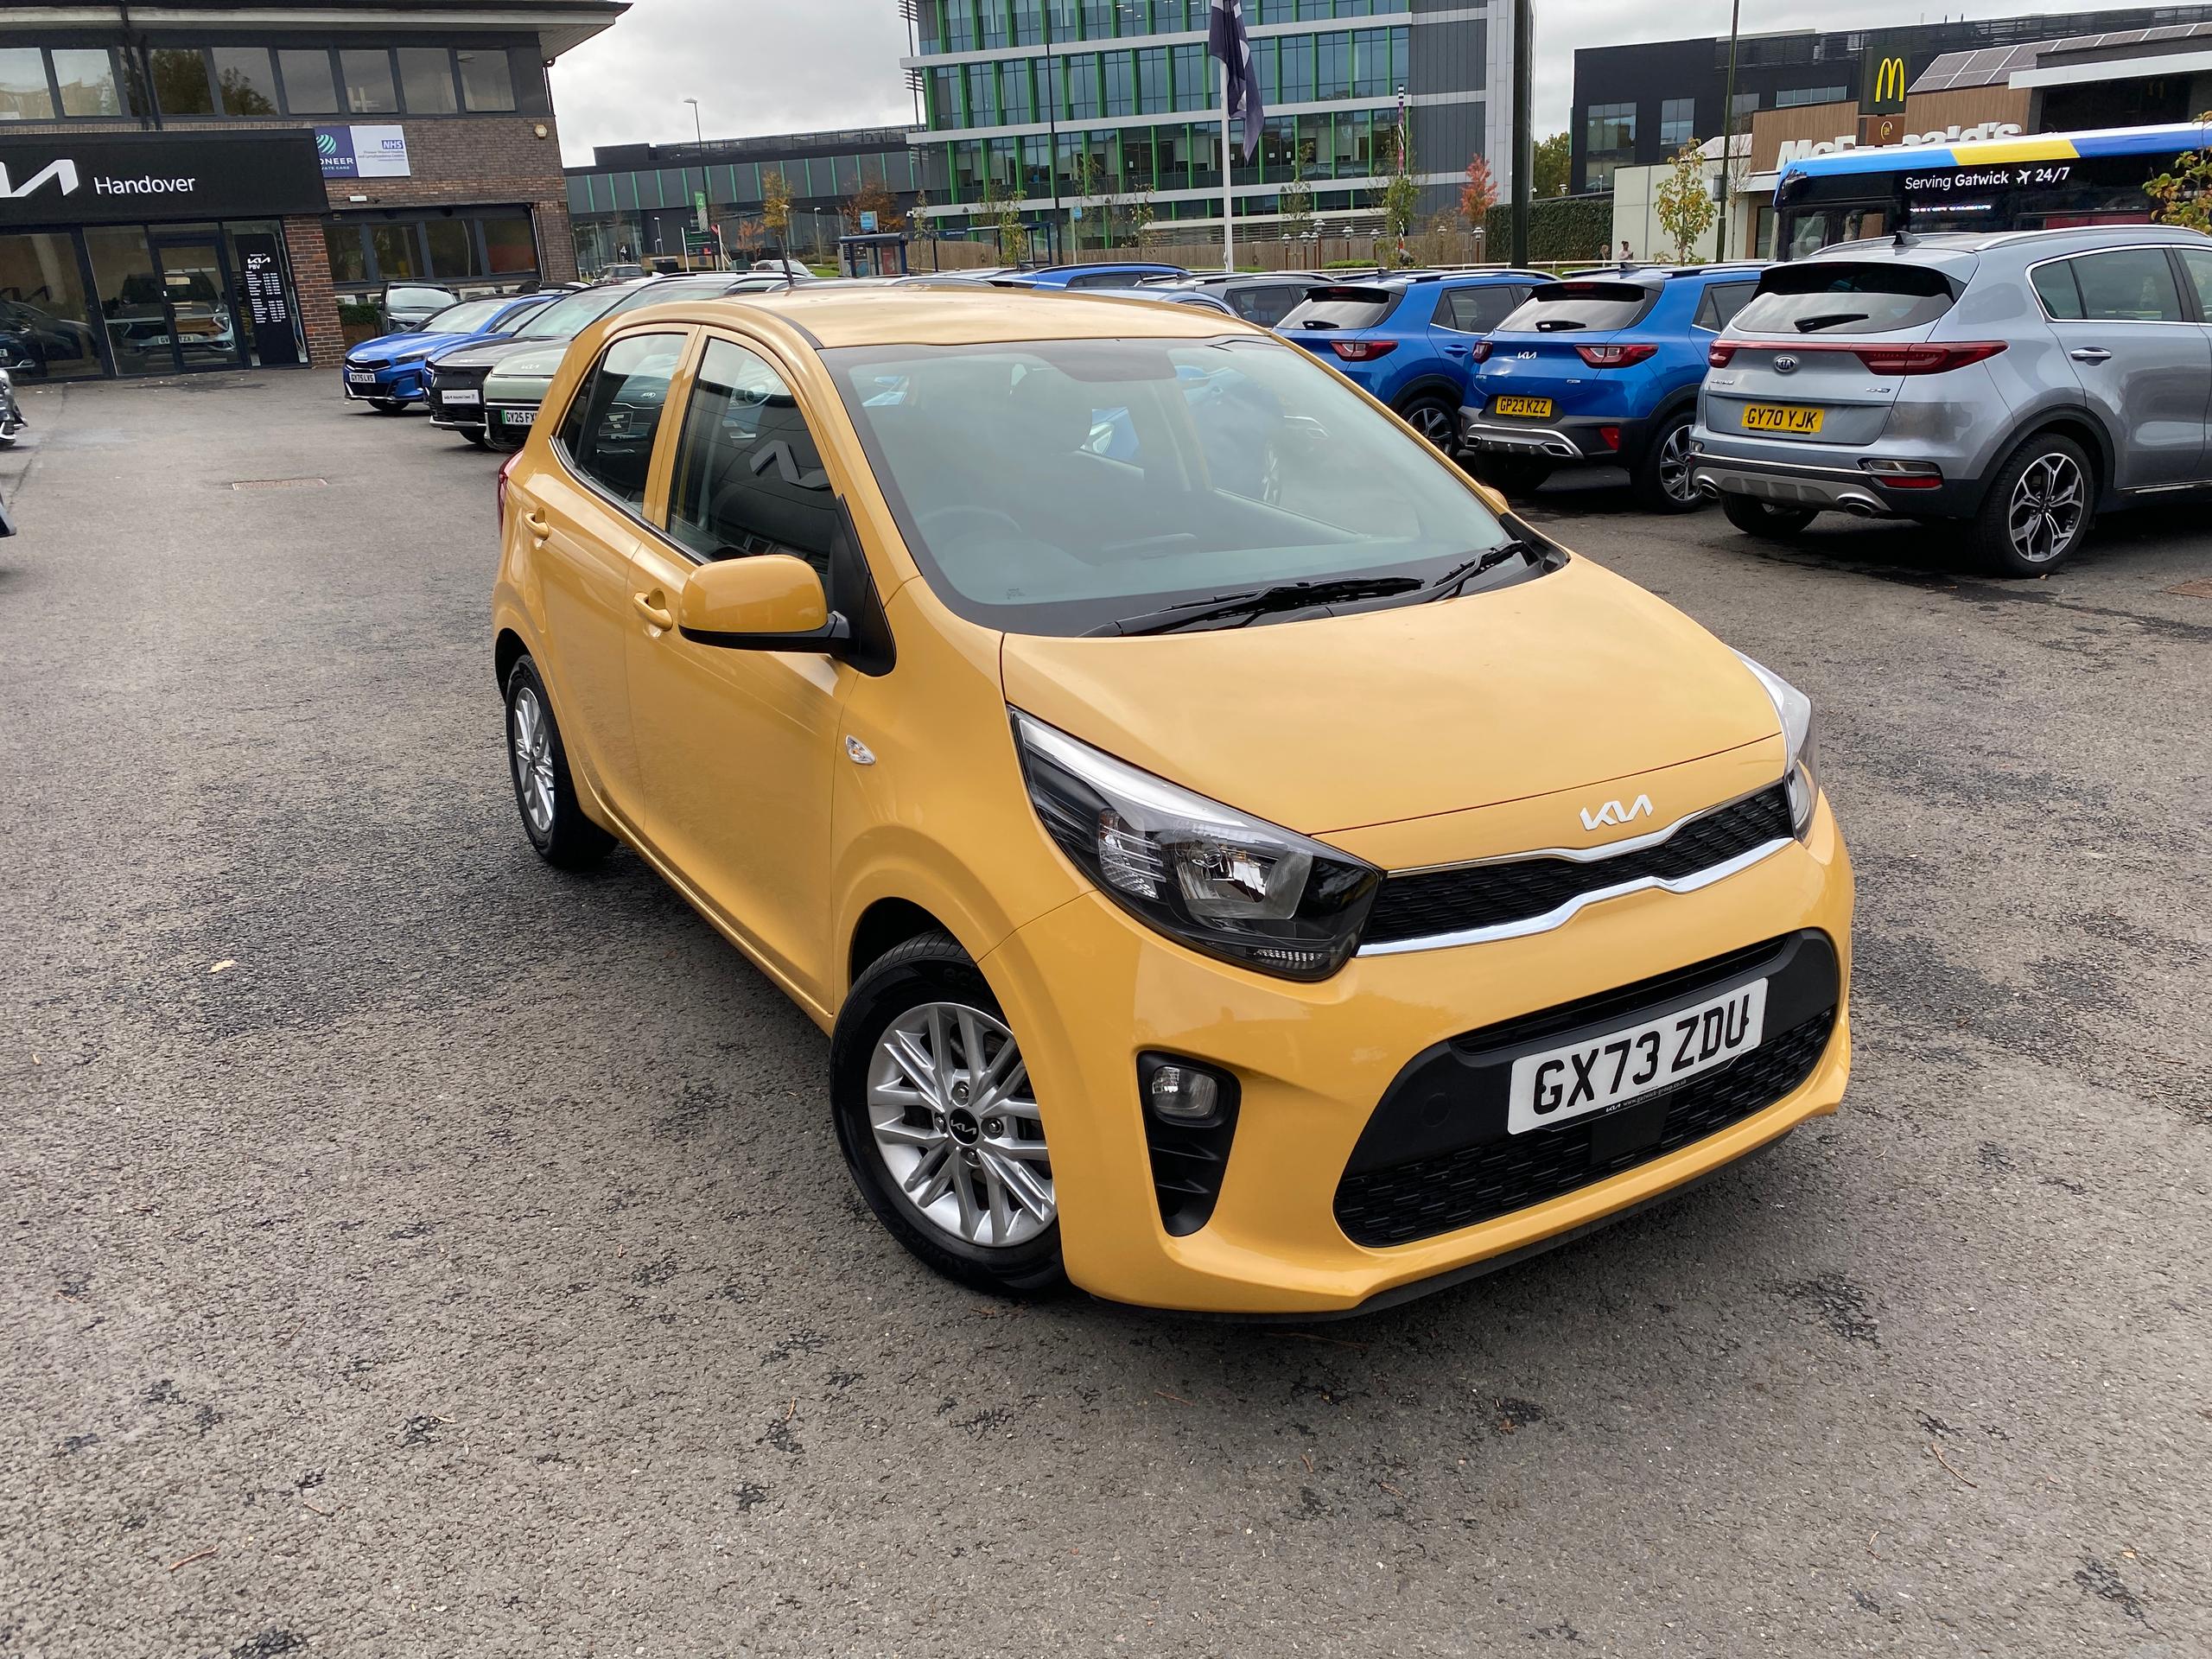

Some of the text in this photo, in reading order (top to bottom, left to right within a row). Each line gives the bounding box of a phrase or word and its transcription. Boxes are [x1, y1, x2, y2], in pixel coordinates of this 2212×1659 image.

[93, 175, 195, 195] Handover
[1904, 167, 2070, 191] Serving Gatwick 24/7
[1516, 351, 1538, 359] KIA
[1777, 359, 1792, 370] KIA
[1500, 397, 1548, 414] GP23 KZZ
[505, 410, 538, 423] GY25 FX
[1746, 408, 1818, 429] GY70 YJK
[1579, 794, 1654, 831] KIA
[1533, 994, 1750, 1116] GX73 ZDU
[950, 1119, 977, 1135] KIA
